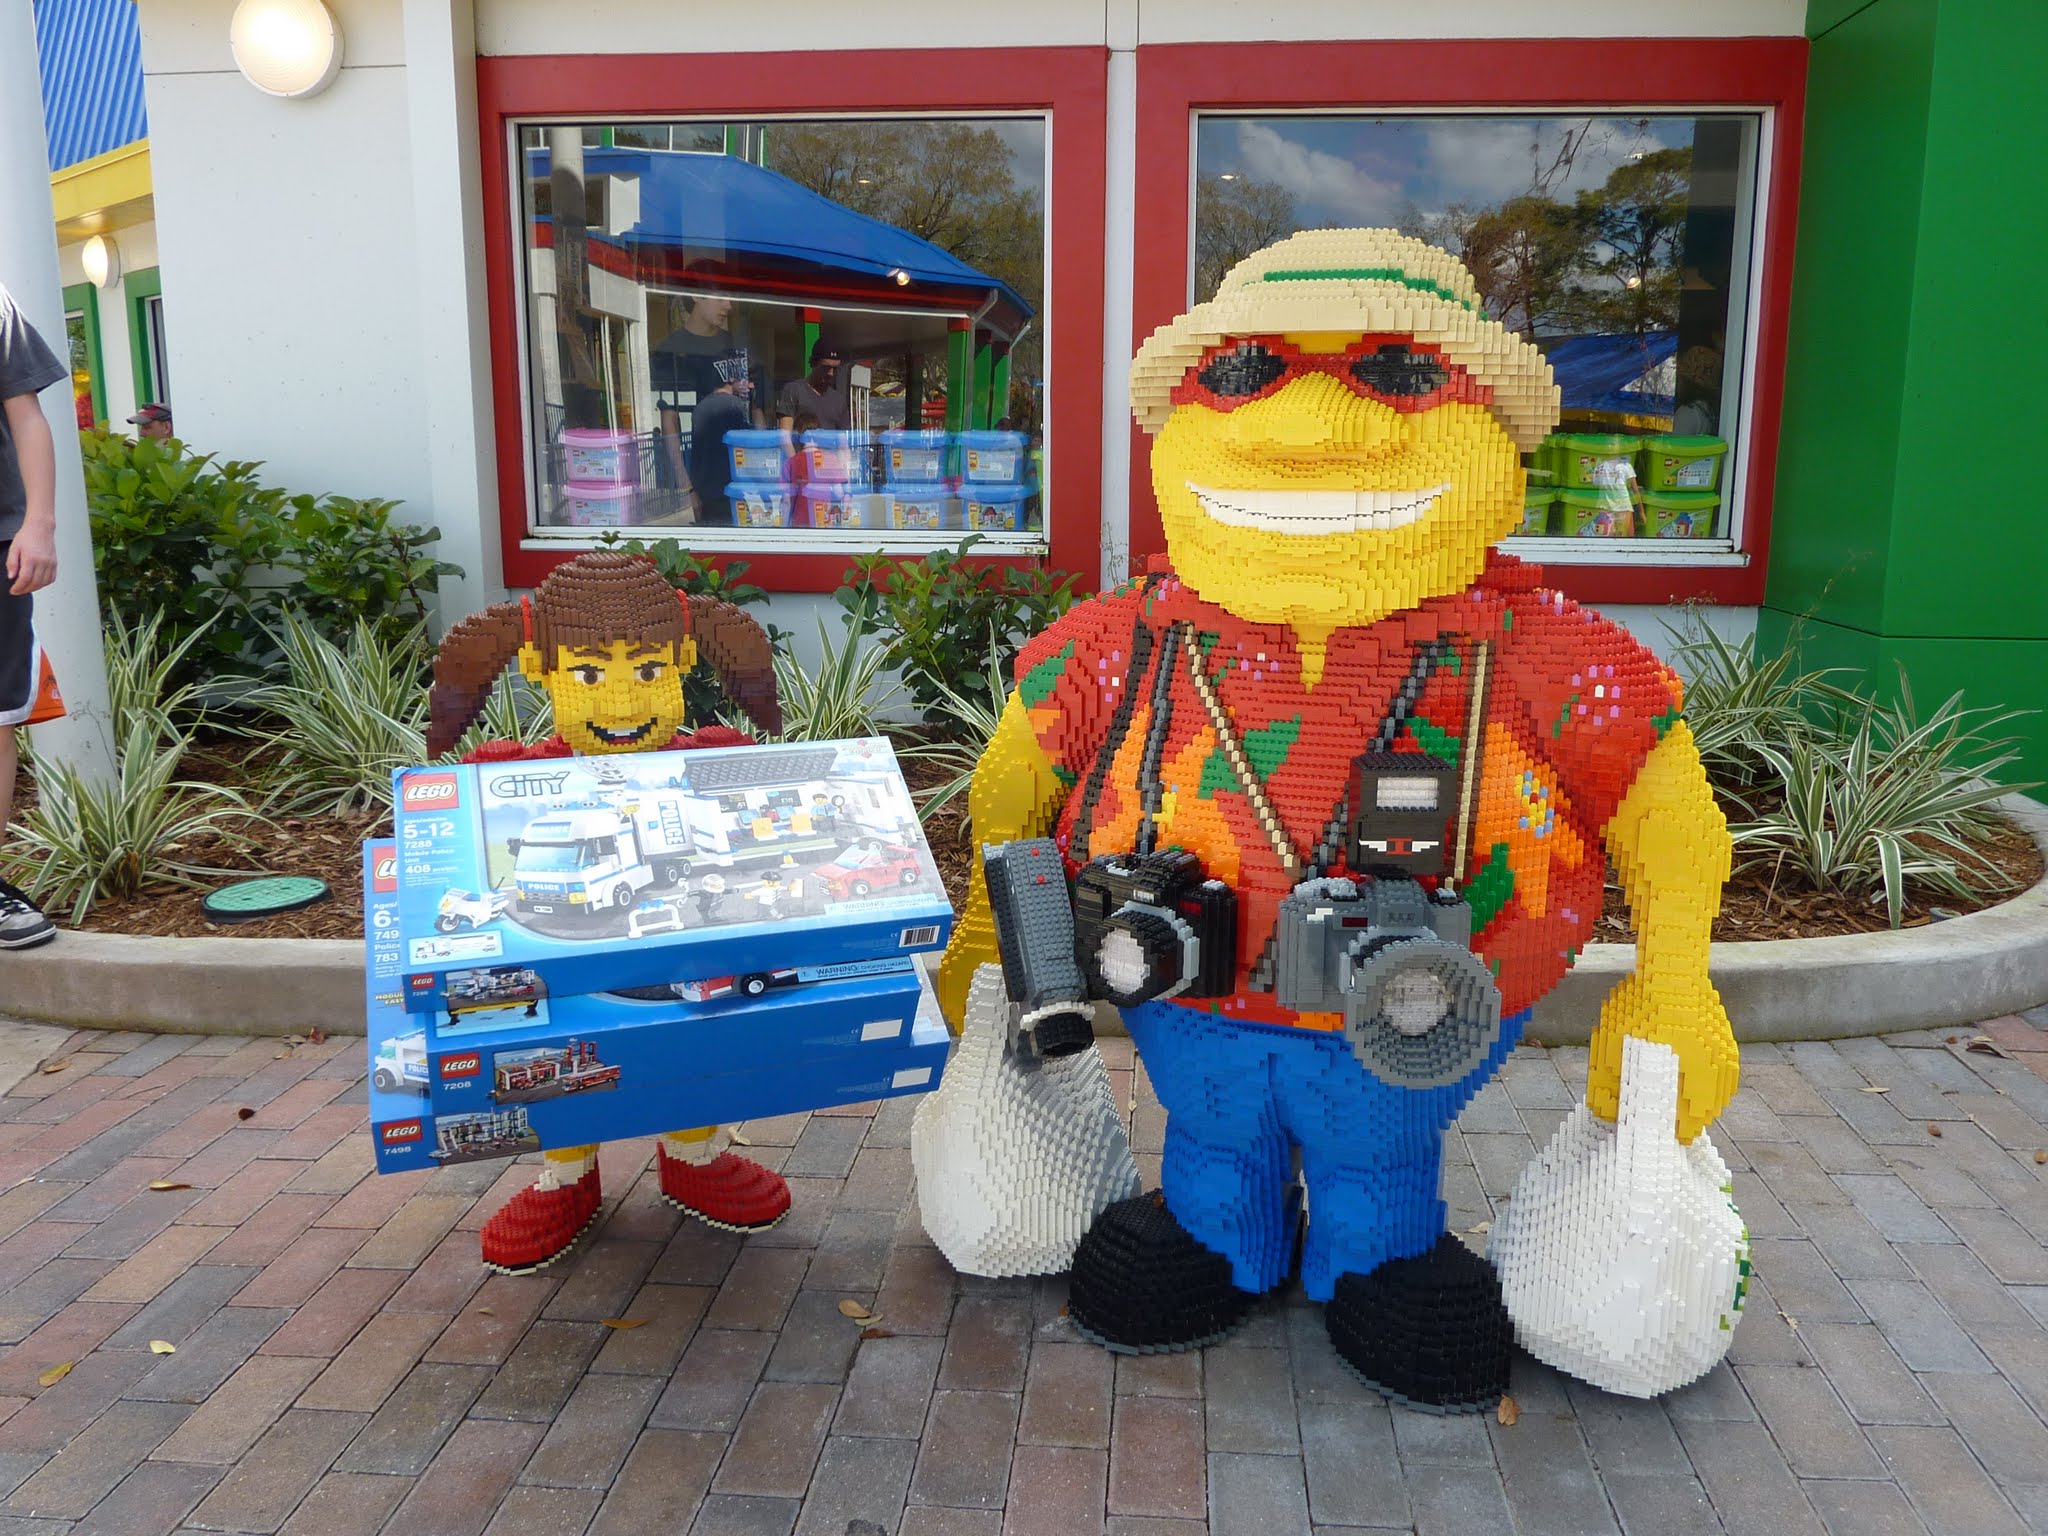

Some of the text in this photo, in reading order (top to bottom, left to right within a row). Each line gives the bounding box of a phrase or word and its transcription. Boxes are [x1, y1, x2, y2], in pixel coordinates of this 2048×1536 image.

[489, 771, 571, 798] CITY
[406, 783, 455, 800] LEGO
[660, 801, 686, 845] POLICE
[403, 822, 455, 839] 5-12
[404, 840, 433, 849] 7288
[405, 864, 431, 874] 408
[527, 883, 560, 891] POLICE
[374, 953, 398, 963] 783
[413, 977, 433, 986] LEGO
[443, 1059, 477, 1072] LEGO
[443, 1081, 472, 1091] 7208
[385, 1126, 418, 1138] LEGO
[383, 1145, 412, 1156] 7498
